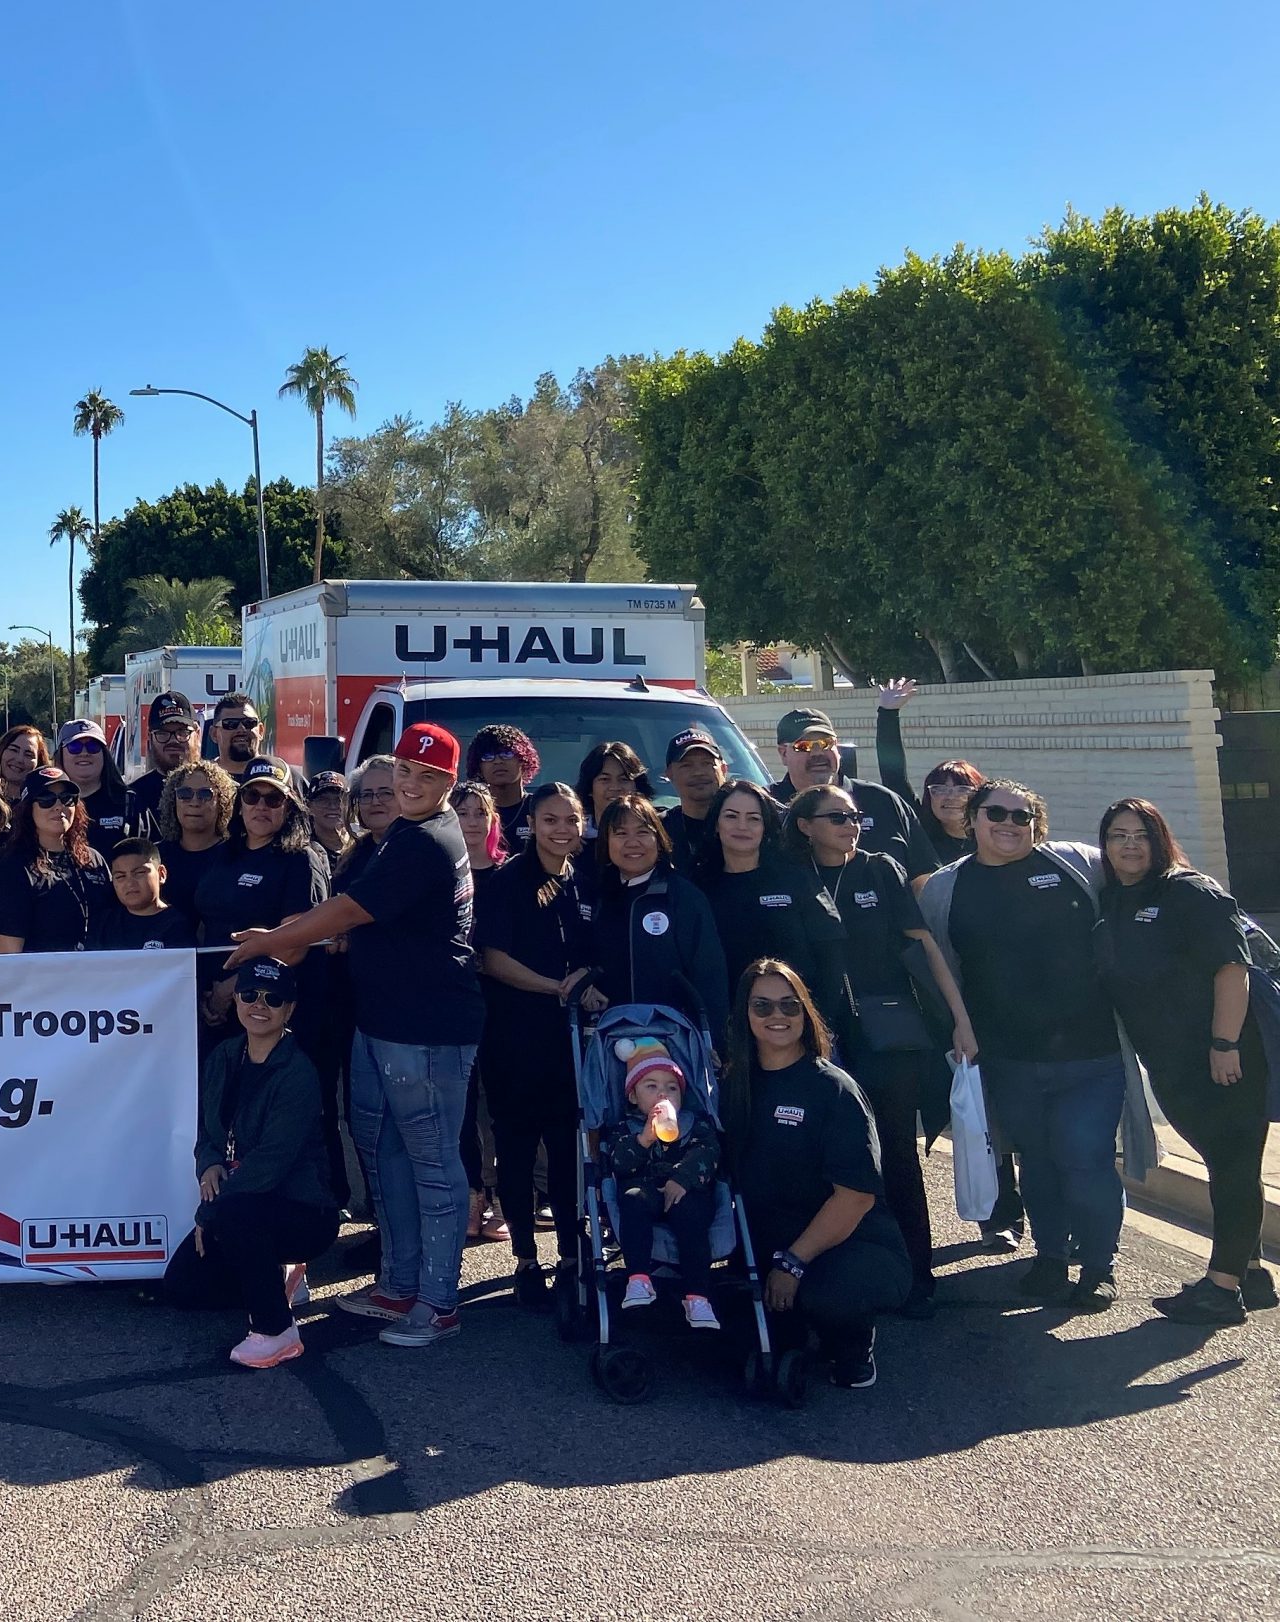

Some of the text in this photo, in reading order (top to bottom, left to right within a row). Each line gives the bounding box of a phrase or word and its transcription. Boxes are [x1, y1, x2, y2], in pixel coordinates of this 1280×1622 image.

[627, 600, 676, 609] TM 6735 M
[280, 622, 320, 663] U-HAUL
[395, 624, 646, 665] U-HAUL
[419, 736, 434, 754] P
[250, 765, 277, 775] ARMY
[28, 1221, 162, 1249] U-HAUL
